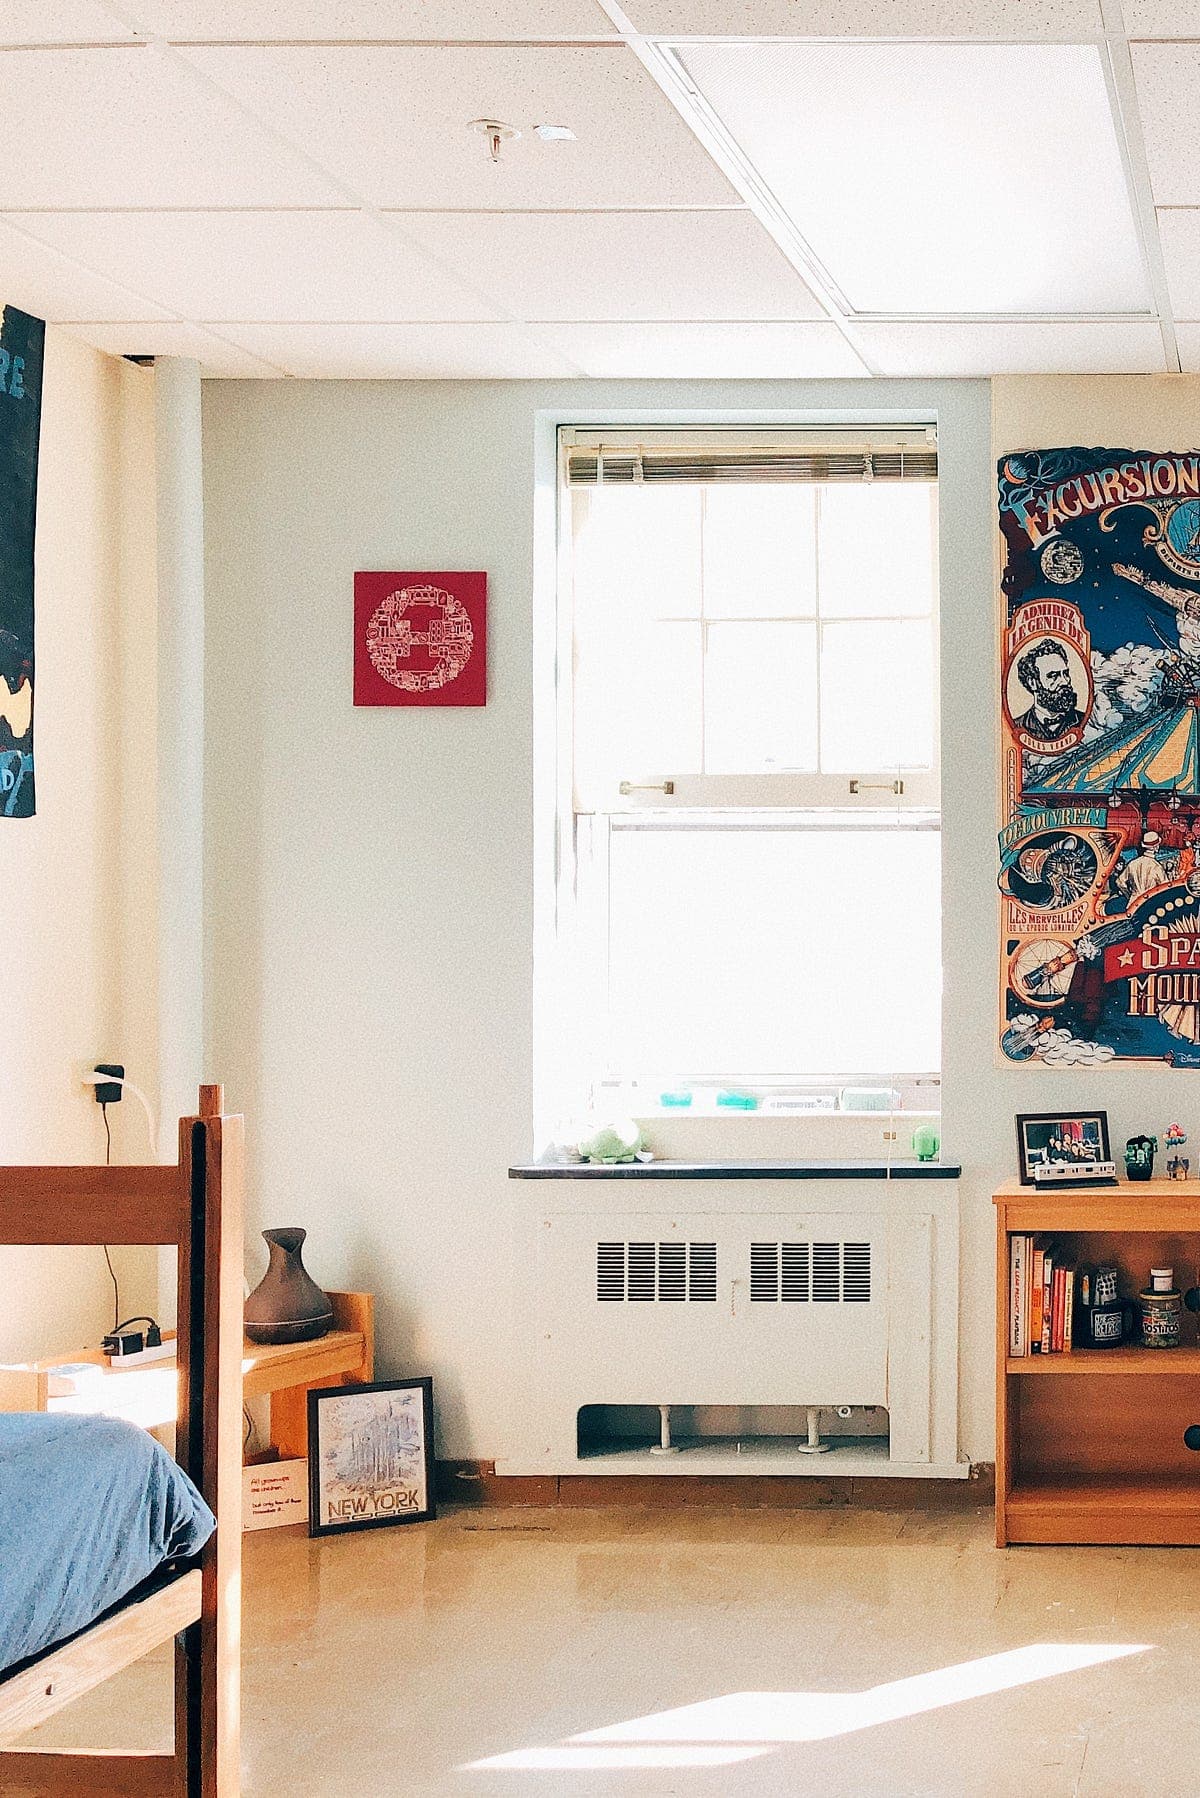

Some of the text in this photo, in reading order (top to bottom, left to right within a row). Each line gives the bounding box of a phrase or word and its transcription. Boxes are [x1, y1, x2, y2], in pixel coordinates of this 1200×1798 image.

[1022, 603, 1075, 621] ADMIREZ
[1009, 902, 1084, 924] LES MERVEILLES
[328, 1489, 419, 1518] NEW YORK
